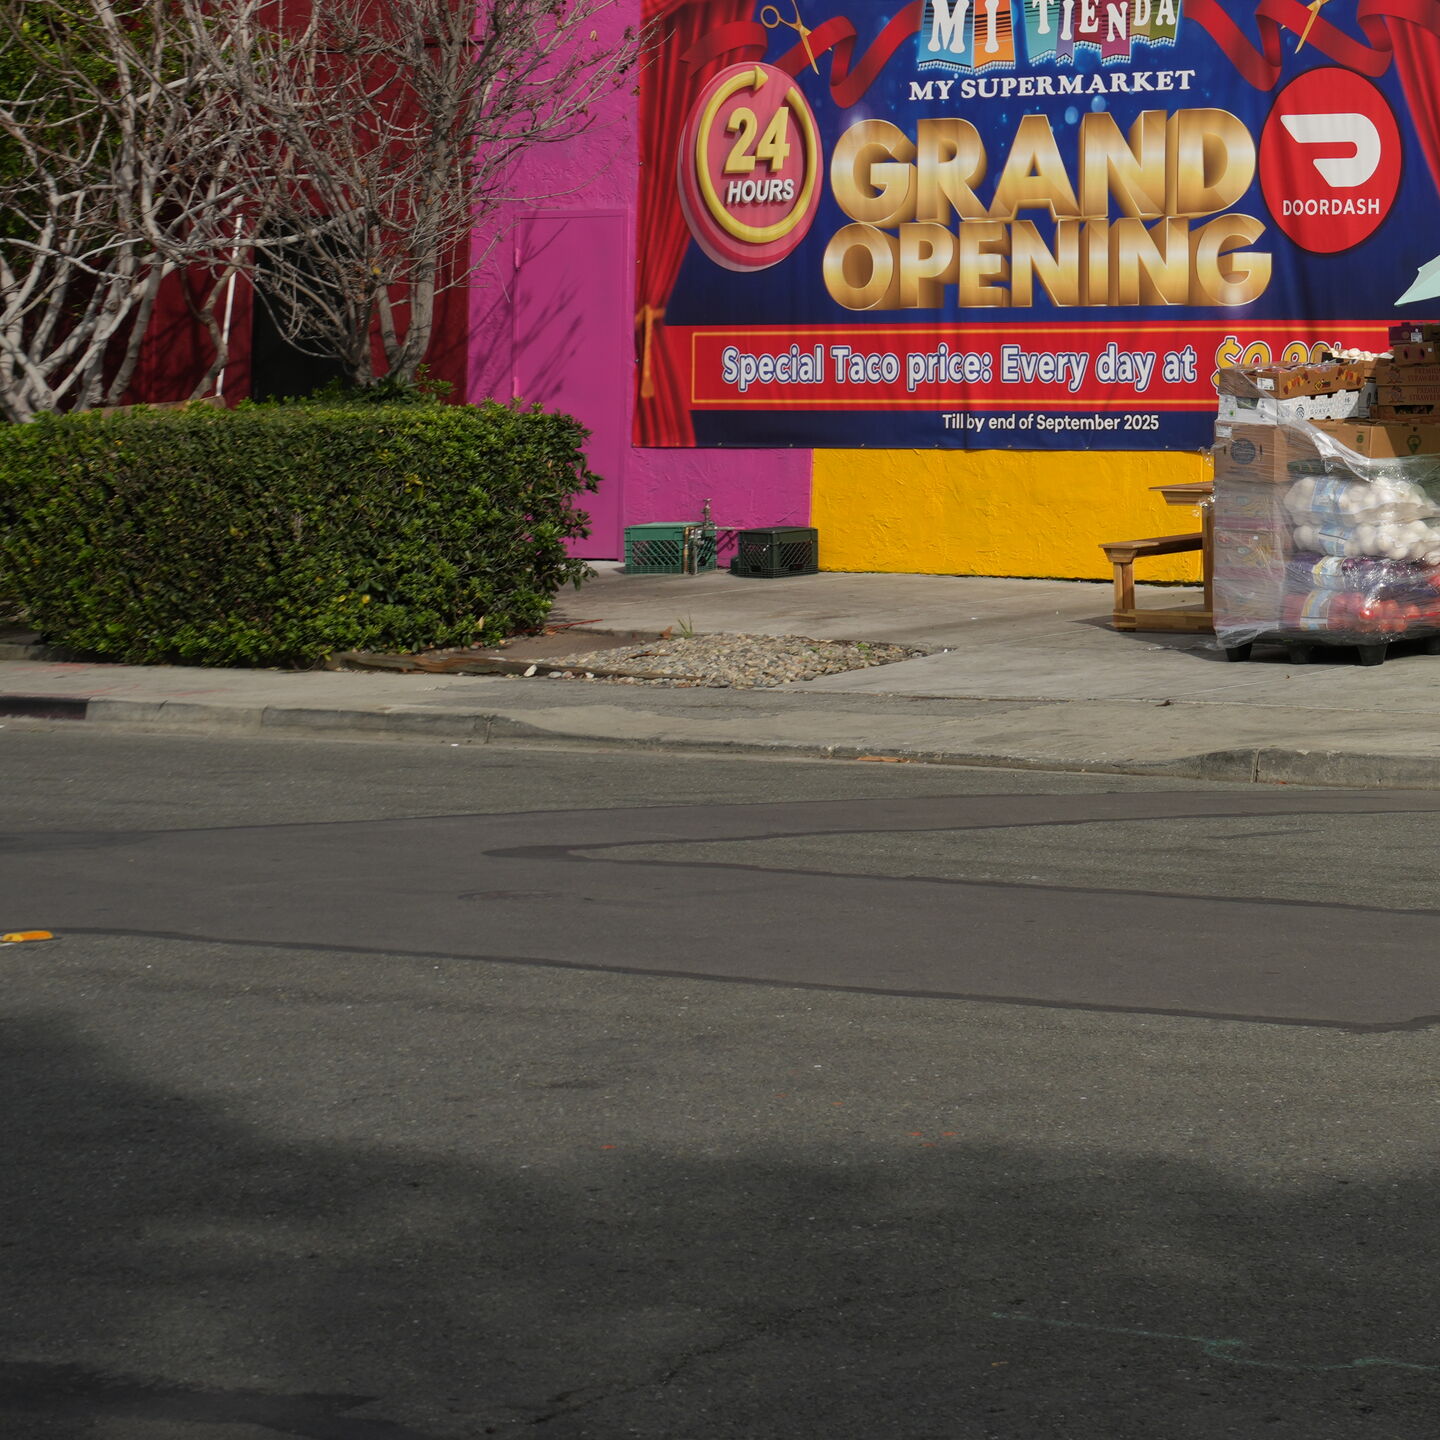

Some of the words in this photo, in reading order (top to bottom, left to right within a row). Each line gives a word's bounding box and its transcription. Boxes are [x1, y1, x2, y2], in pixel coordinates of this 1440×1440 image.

[908, 79, 955, 101] MY
[960, 69, 1196, 99] SUPERMARKET
[726, 106, 791, 173] 24
[831, 107, 1256, 228] GRAND
[727, 178, 795, 204] HOURS
[1282, 198, 1380, 216] DOORDASH
[823, 213, 1272, 310] OPENING
[722, 343, 824, 393] Special
[831, 345, 901, 384] Taco
[907, 342, 992, 392] price:
[1001, 344, 1090, 393] Every
[1095, 342, 1155, 393] day
[1162, 345, 1198, 384] at
[942, 414, 964, 430] Till
[966, 413, 985, 432] by
[988, 413, 1016, 430] end
[1019, 413, 1034, 430] of
[1036, 413, 1121, 434] September
[1123, 414, 1160, 431] 2025
